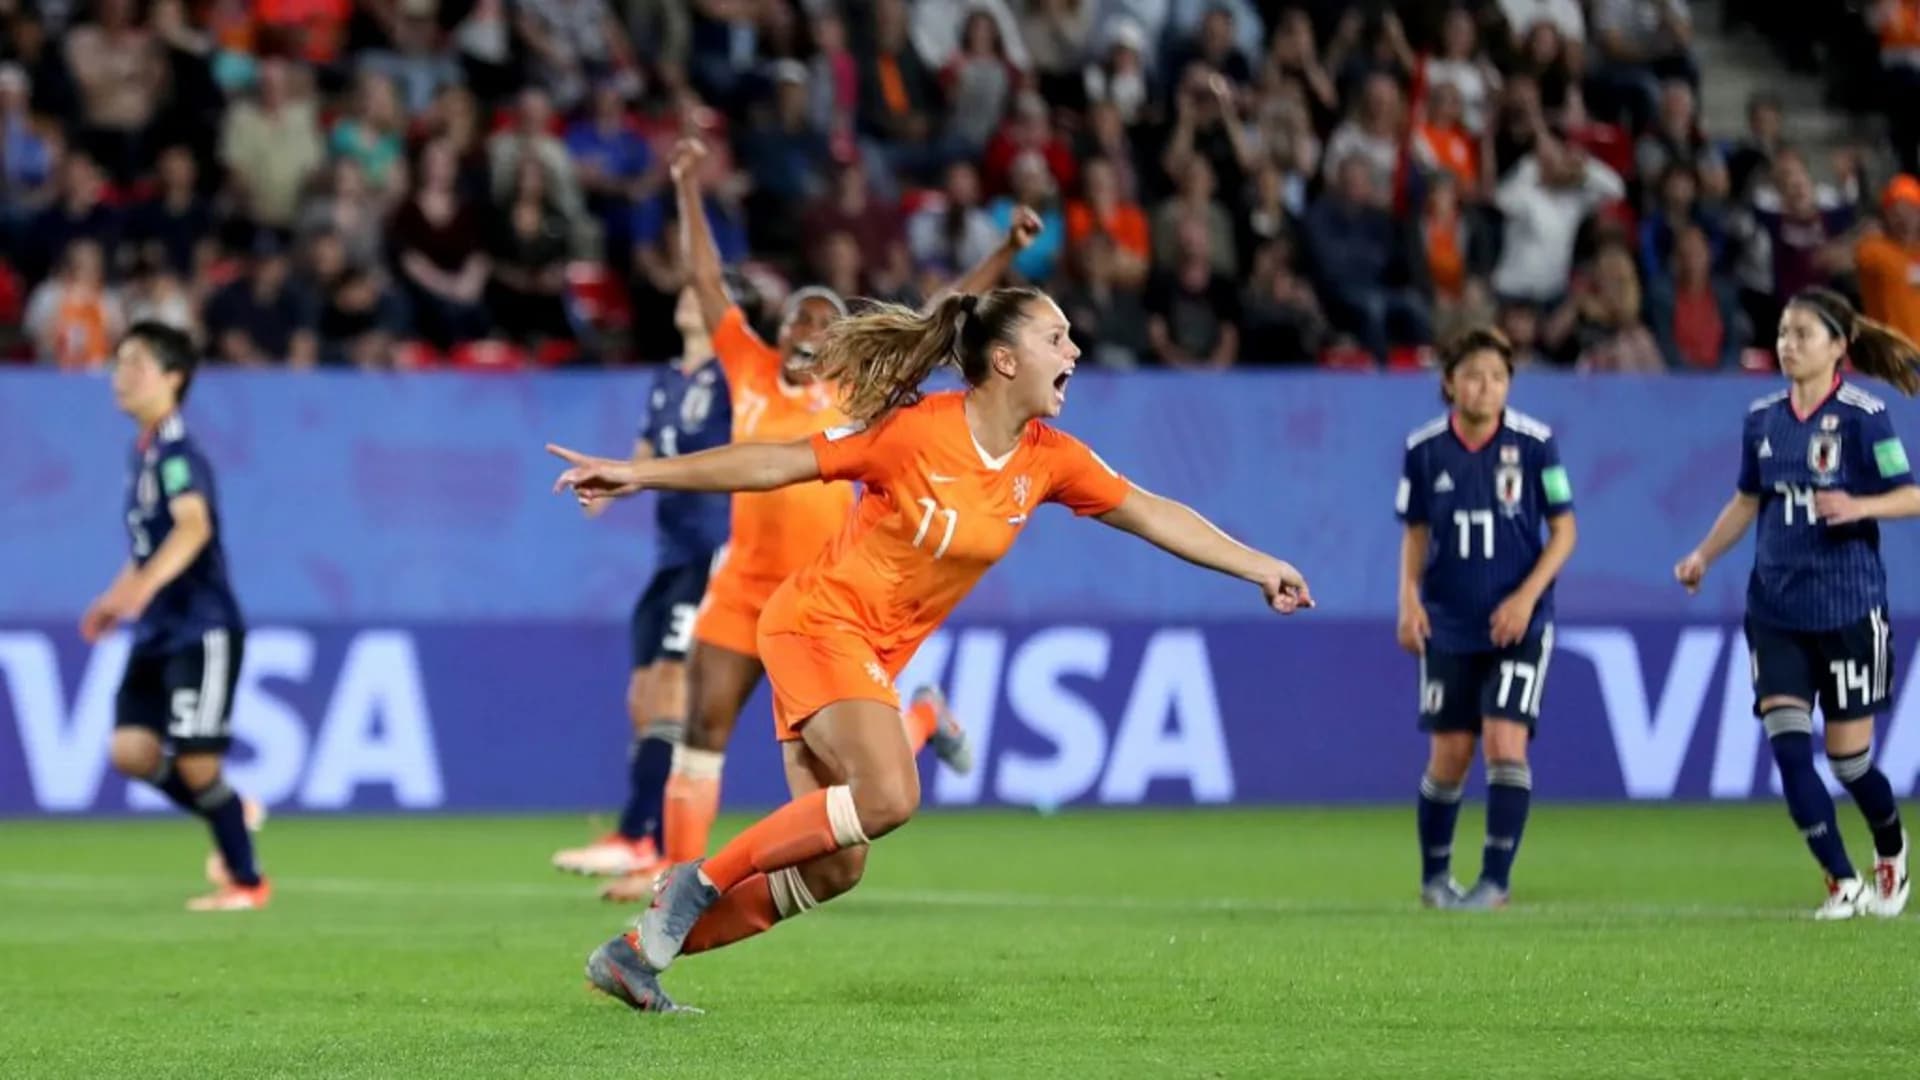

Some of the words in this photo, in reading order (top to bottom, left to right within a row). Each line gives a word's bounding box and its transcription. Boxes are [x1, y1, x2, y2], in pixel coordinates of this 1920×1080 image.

[1764, 481, 1817, 526] 14
[1453, 509, 1495, 559] 17
[661, 603, 697, 652] 3
[1496, 661, 1537, 714] 17
[1829, 659, 1871, 709] 14
[0, 627, 446, 812] VSA
[168, 689, 201, 738] 5
